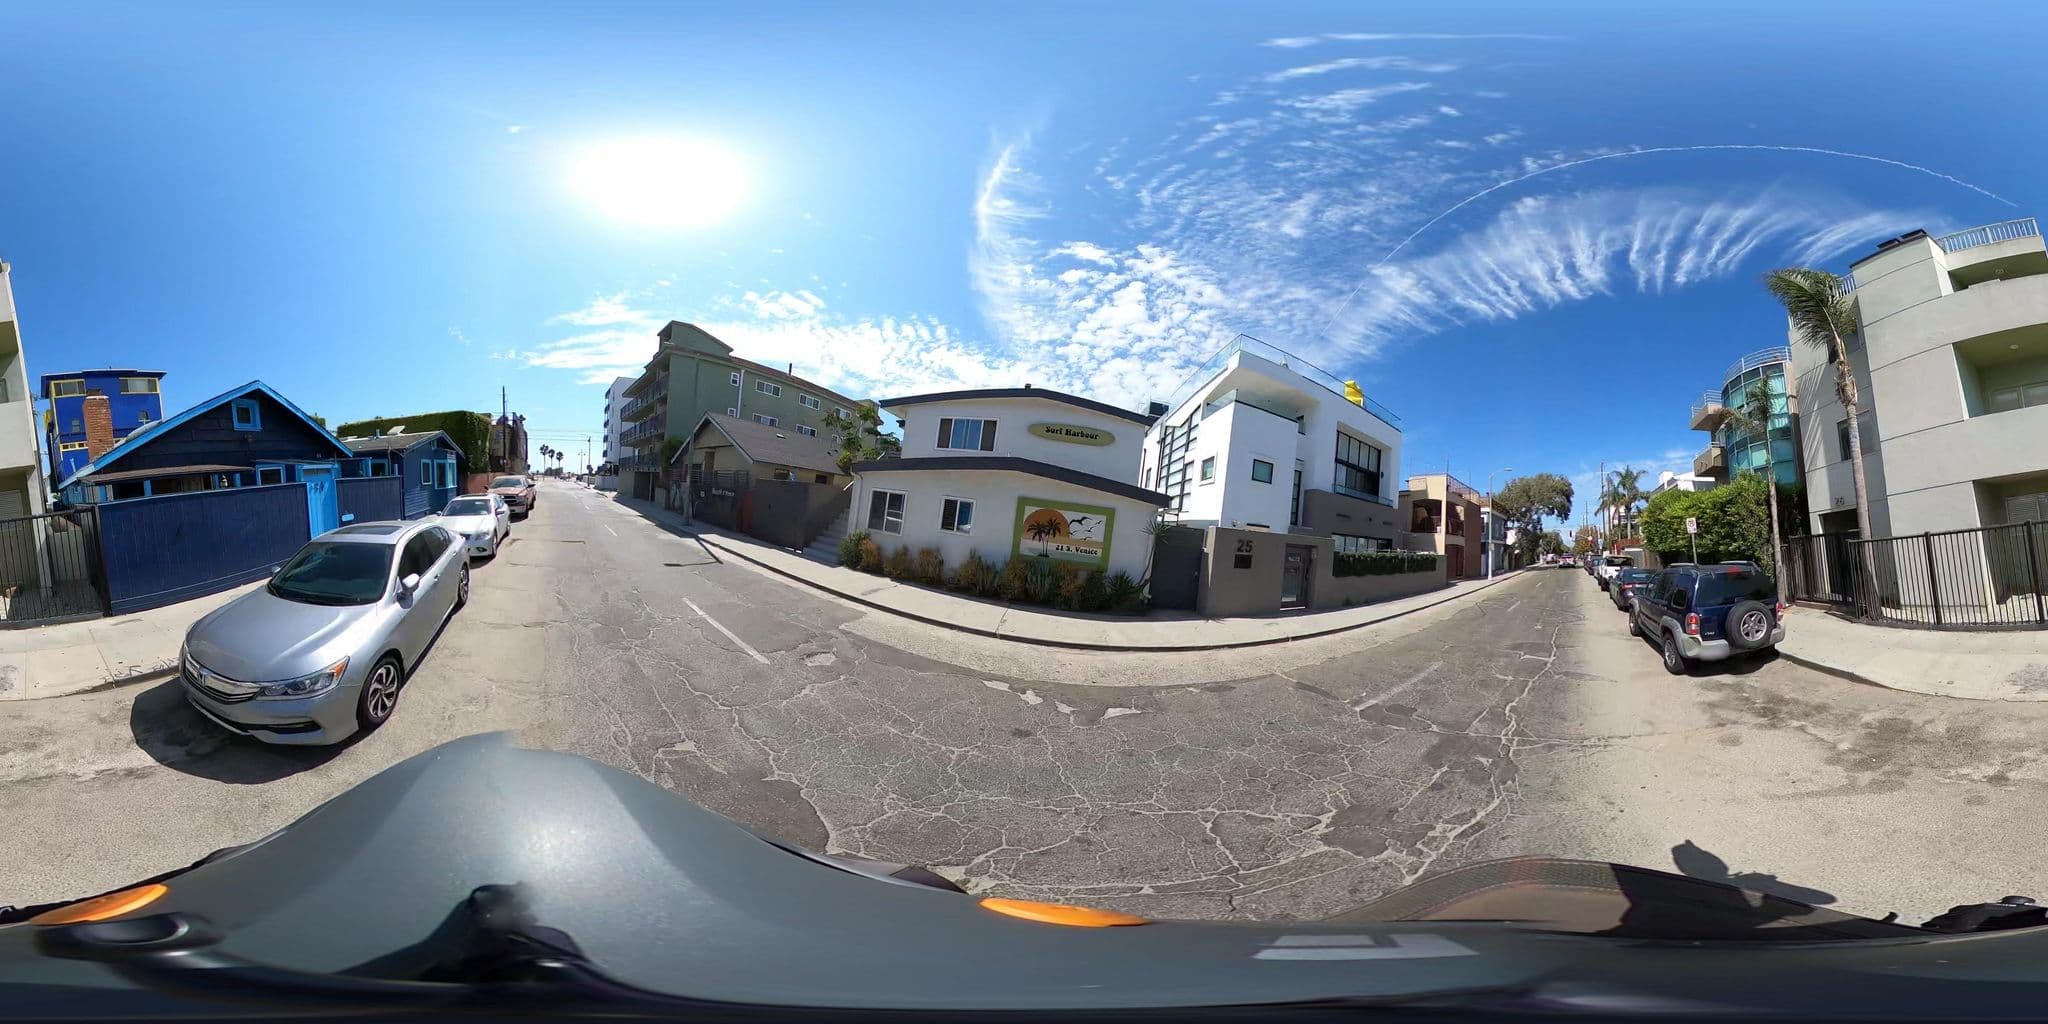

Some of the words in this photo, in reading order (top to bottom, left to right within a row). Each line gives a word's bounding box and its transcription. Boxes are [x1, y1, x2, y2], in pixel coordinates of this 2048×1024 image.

[1045, 425, 1062, 435] Surf
[1065, 428, 1099, 440] Harbour
[1075, 546, 1098, 556] Venice
[1236, 539, 1253, 553] 25
